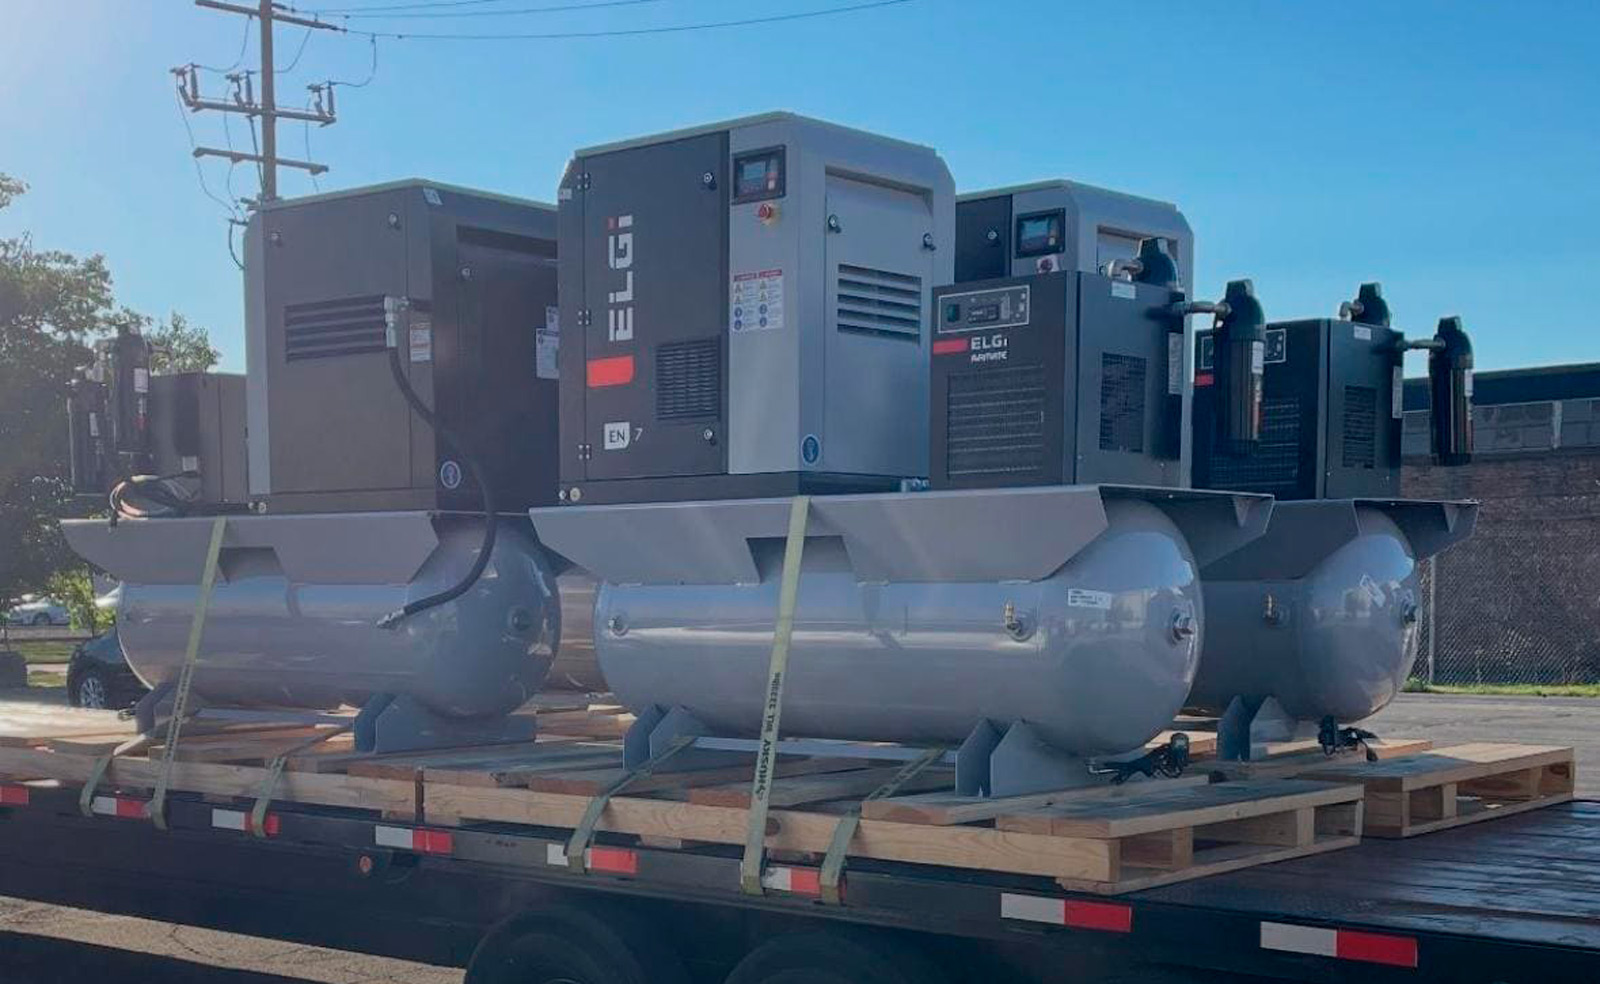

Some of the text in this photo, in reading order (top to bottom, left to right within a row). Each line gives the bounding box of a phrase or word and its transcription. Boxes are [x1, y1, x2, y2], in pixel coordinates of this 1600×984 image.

[609, 427, 643, 443] EN 7
[758, 739, 771, 784] HUSKY
